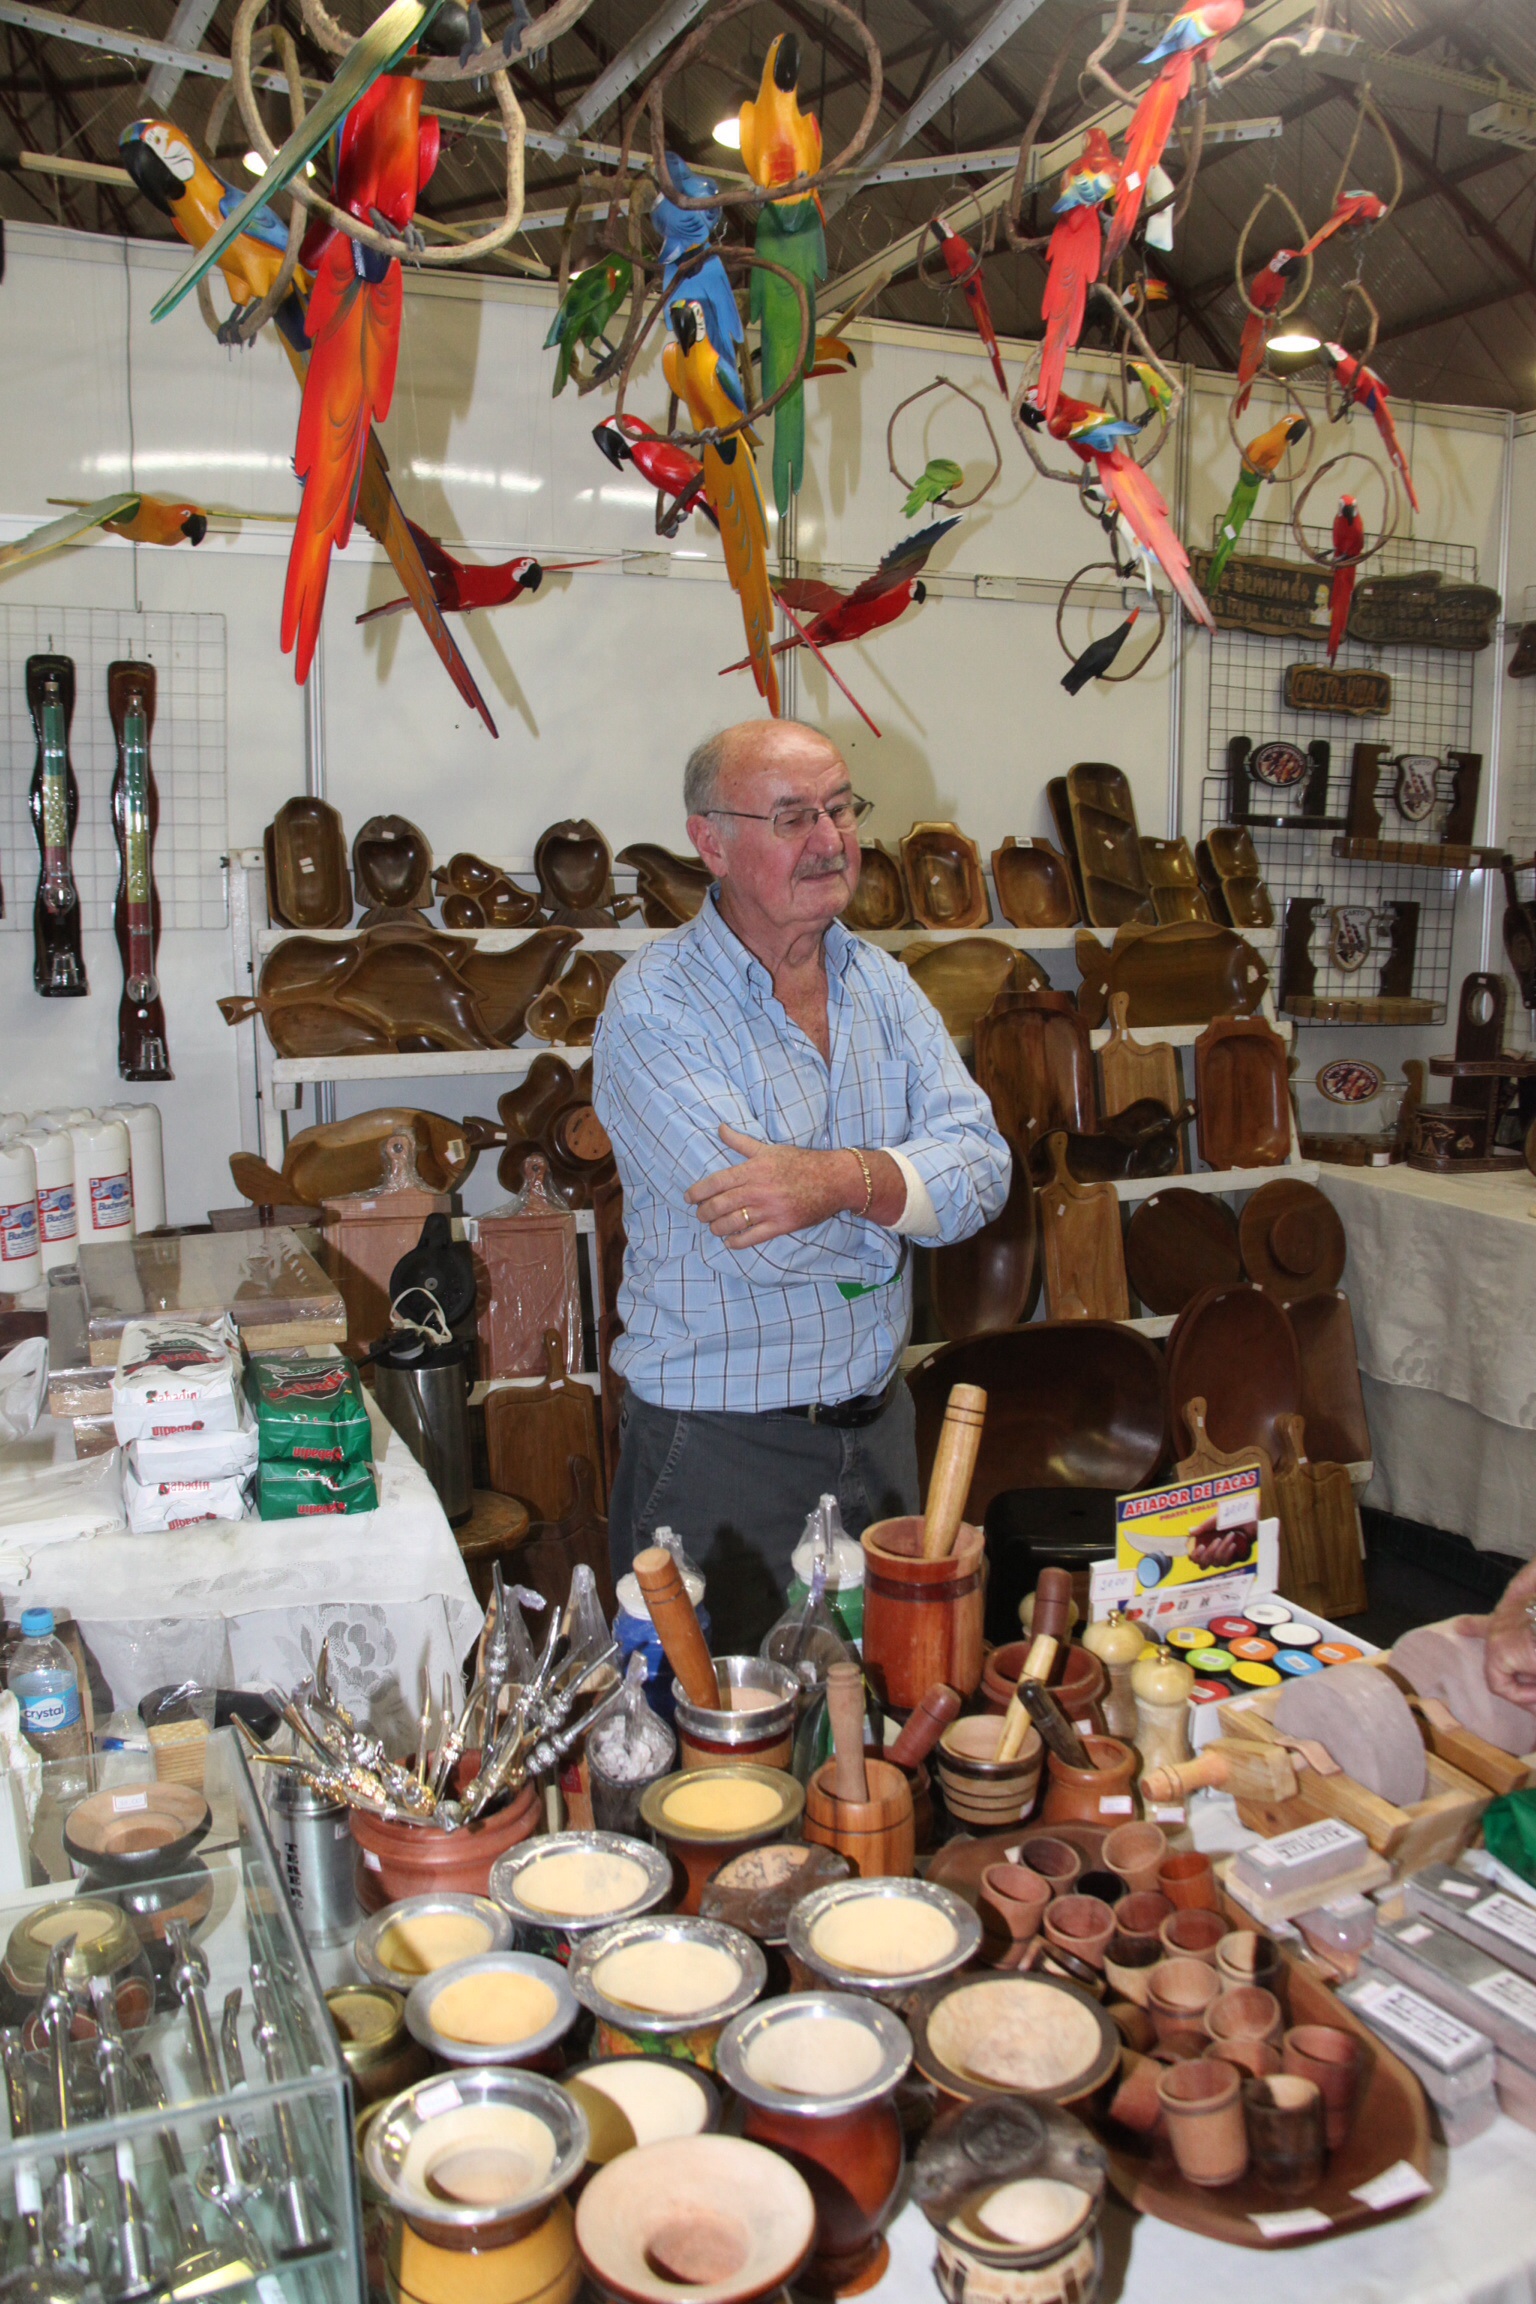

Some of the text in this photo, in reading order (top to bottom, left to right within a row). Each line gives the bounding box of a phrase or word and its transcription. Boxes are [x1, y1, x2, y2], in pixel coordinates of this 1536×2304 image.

[1121, 1471, 1258, 1519] AFIADOR DE FACAS
[23, 1704, 65, 1720] crystal
